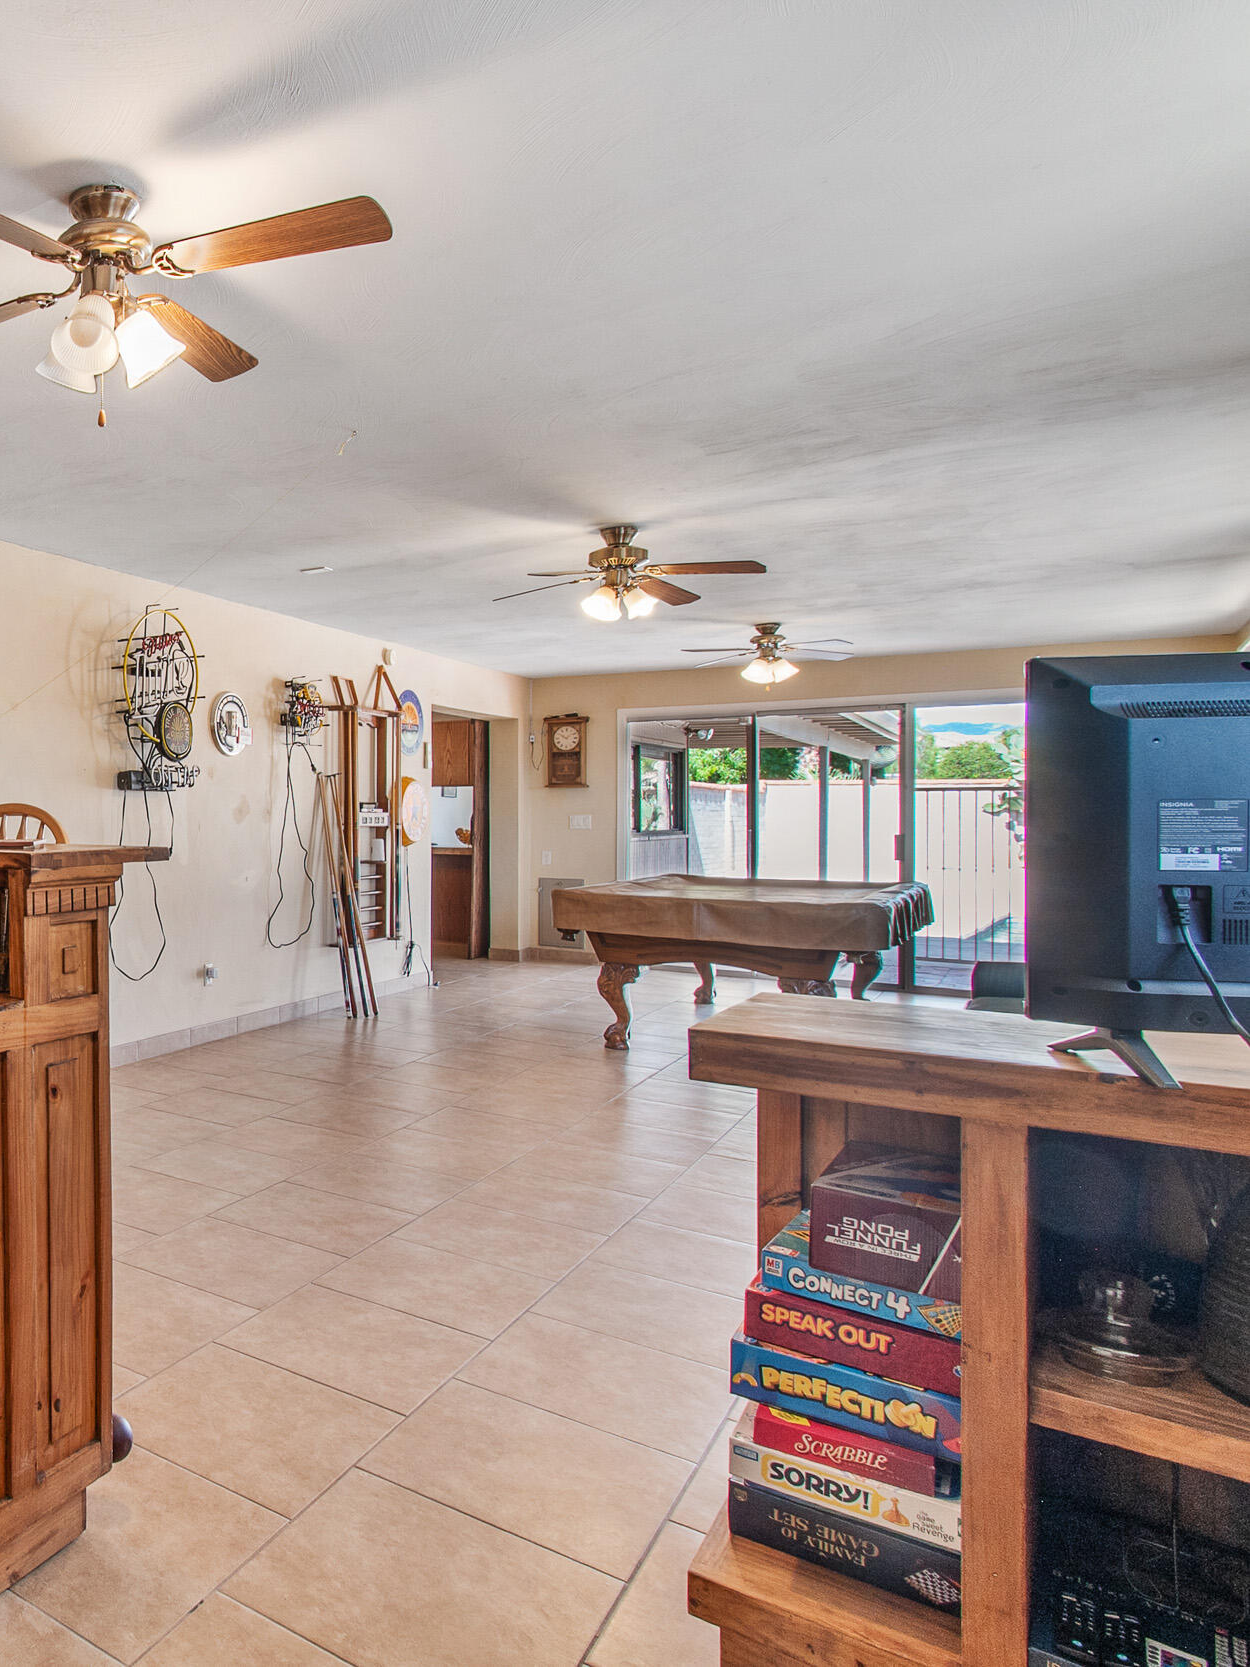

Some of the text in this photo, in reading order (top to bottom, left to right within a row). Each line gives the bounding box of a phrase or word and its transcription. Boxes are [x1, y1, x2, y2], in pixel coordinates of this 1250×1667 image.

[826, 1223, 921, 1254] FUNNEL
[833, 1238, 856, 1247] ROW
[842, 1216, 909, 1240] PONG
[867, 1245, 878, 1253] IN
[879, 1247, 914, 1260] THREE
[787, 1266, 911, 1320] CONNECT 4
[760, 1303, 894, 1355] SPEAK OUT
[794, 1433, 888, 1471] SCRABBLE
[769, 1461, 871, 1511] SORRY!
[766, 1507, 880, 1557] GAME SET
[912, 1522, 955, 1543] Revenge
[804, 1536, 867, 1567] FAMILY
